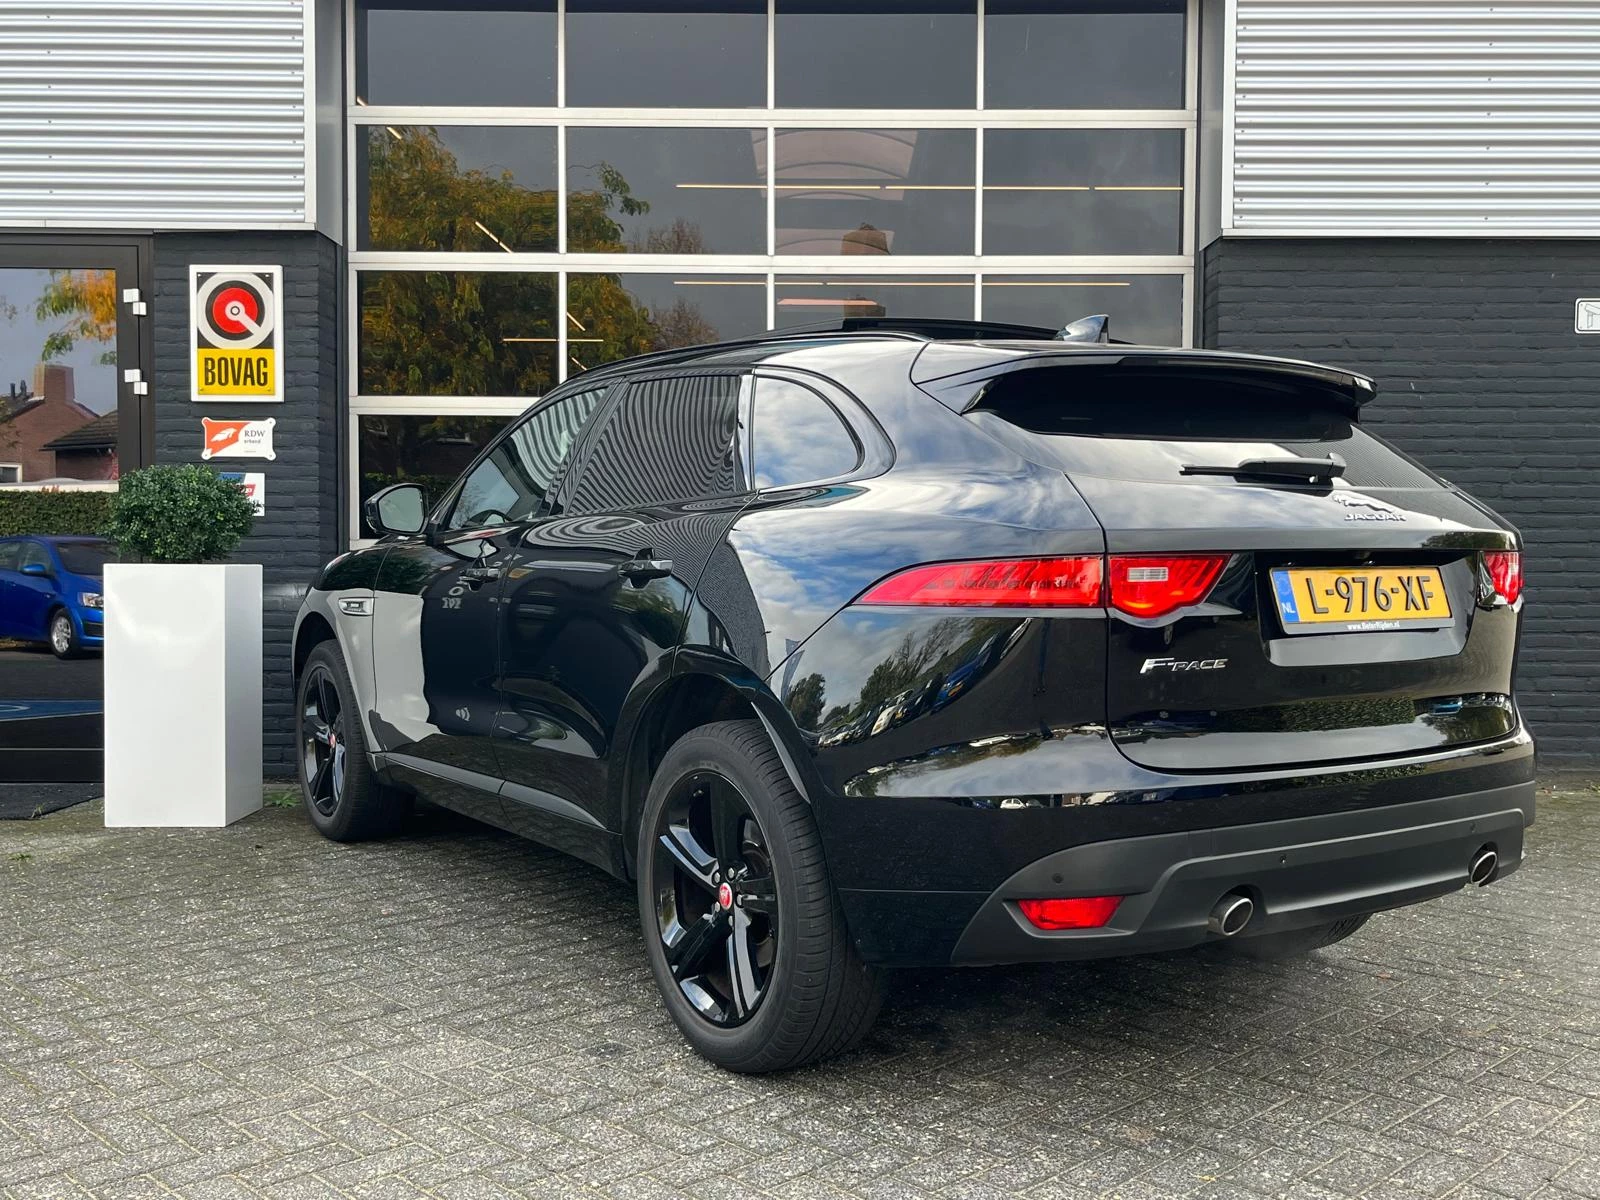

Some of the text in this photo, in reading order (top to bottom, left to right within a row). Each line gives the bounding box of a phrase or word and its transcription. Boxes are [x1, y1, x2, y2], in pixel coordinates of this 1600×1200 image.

[204, 357, 268, 386] BOVAG
[1344, 513, 1407, 521] JAGUAR
[1306, 576, 1434, 614] L-976-XF
[1281, 602, 1296, 613] NL
